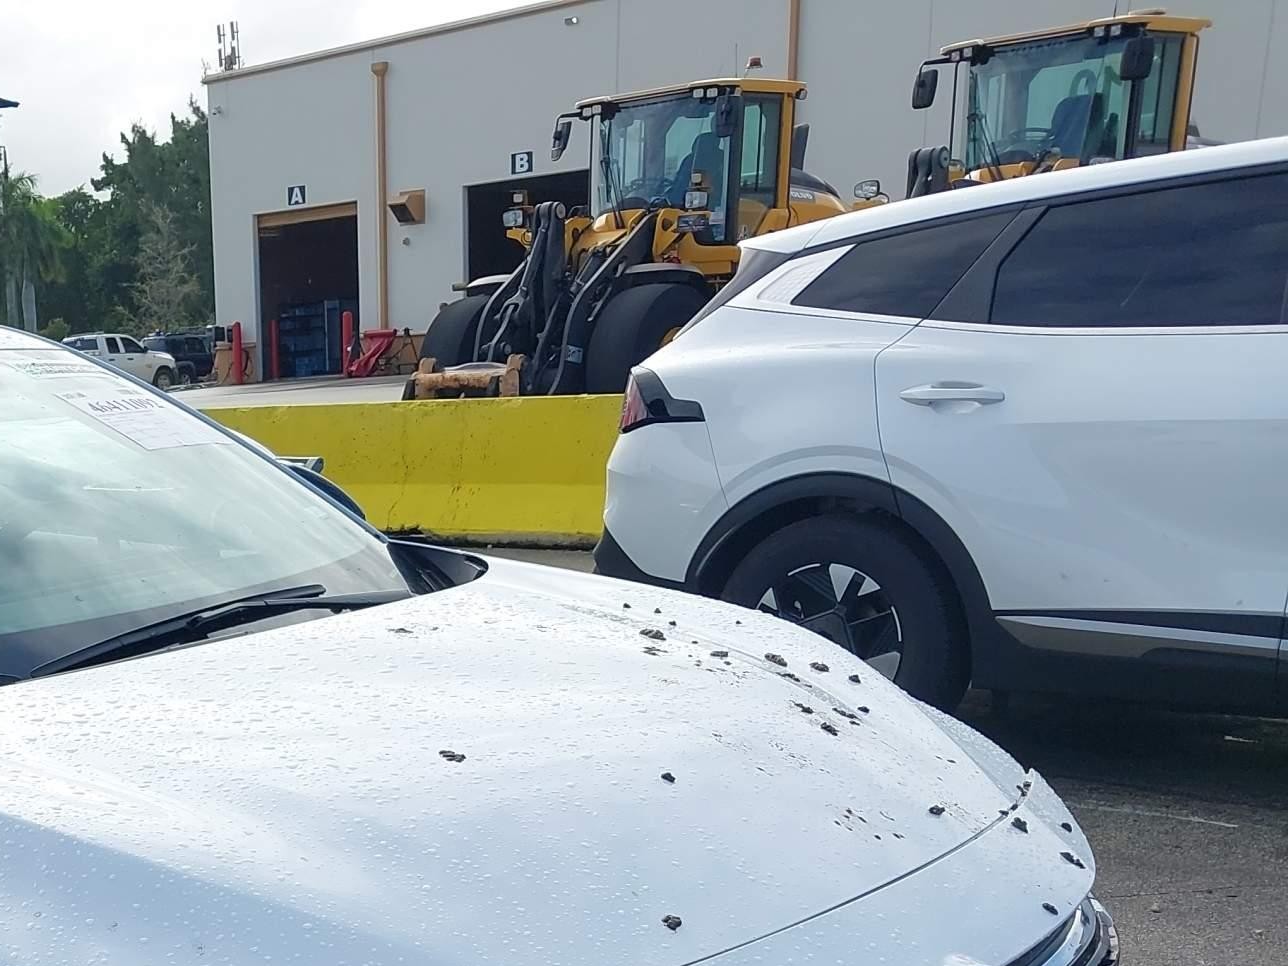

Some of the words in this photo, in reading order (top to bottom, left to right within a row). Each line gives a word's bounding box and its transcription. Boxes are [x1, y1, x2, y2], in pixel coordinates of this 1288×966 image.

[515, 153, 529, 173] B
[291, 187, 303, 204] A
[88, 399, 165, 412] 46411092
